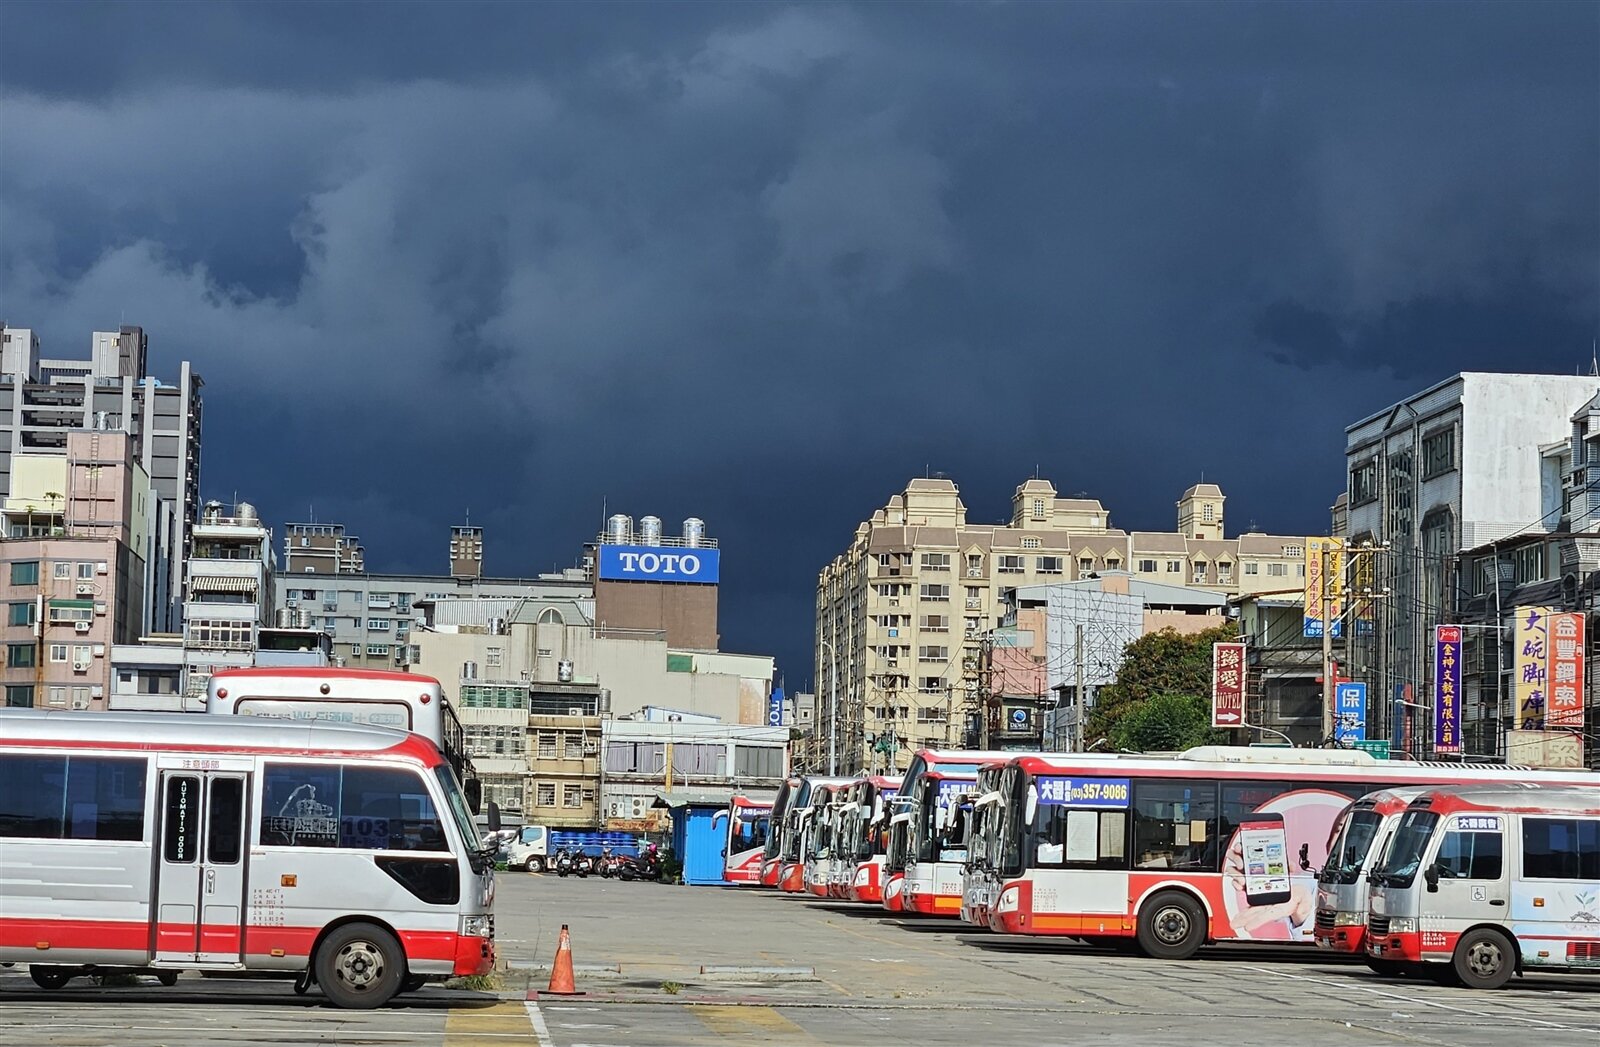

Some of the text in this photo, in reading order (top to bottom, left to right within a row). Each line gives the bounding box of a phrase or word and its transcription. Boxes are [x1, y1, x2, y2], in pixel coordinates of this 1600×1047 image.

[619, 553, 701, 575] TOTO
[1555, 617, 1577, 706] 益豐鋼索
[1217, 691, 1241, 709] MOTEL
[1442, 643, 1455, 744] 金神文教有限公司
[1071, 783, 1127, 801] (03)357-9086
[341, 817, 389, 837] 103
